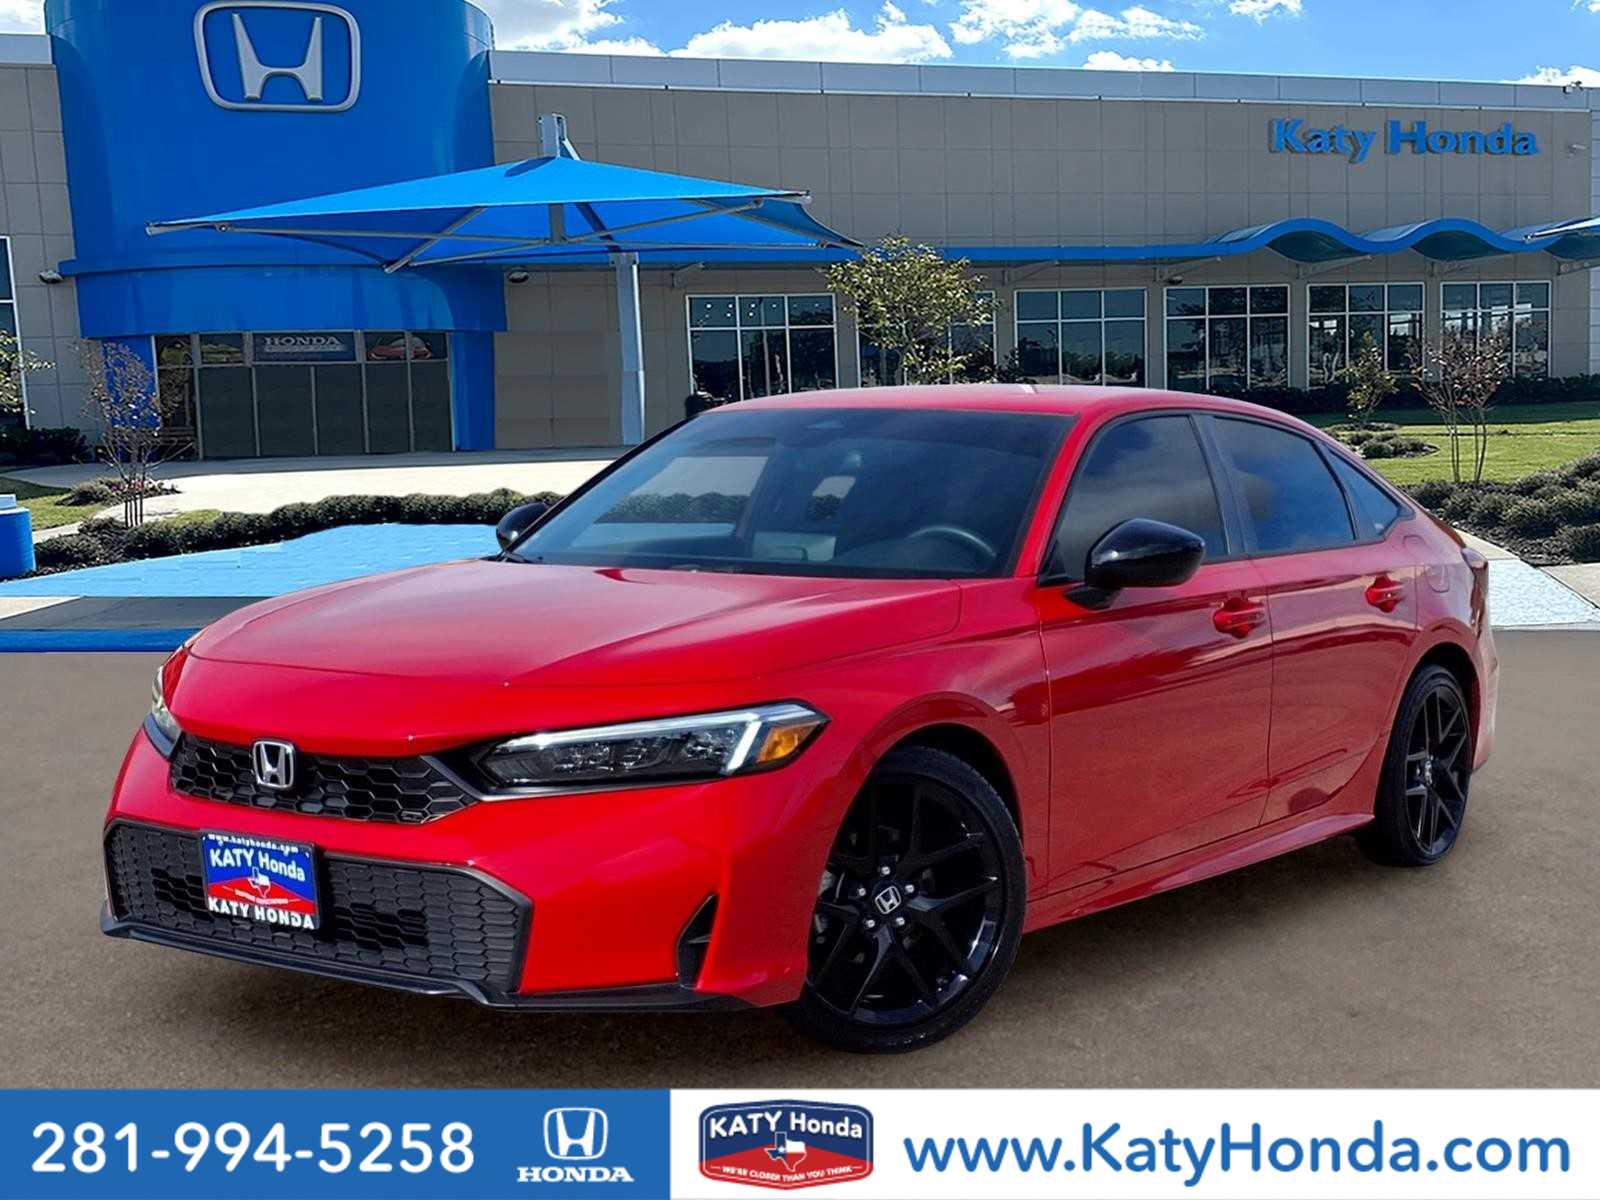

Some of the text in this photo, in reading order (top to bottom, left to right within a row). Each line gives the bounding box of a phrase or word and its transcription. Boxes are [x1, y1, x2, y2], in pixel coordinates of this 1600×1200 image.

[1270, 117, 1540, 165] Katy Honda
[264, 336, 342, 346] HONDA
[209, 847, 306, 882] KATY Honda
[208, 895, 250, 918] KATY
[254, 904, 315, 930] HONDA
